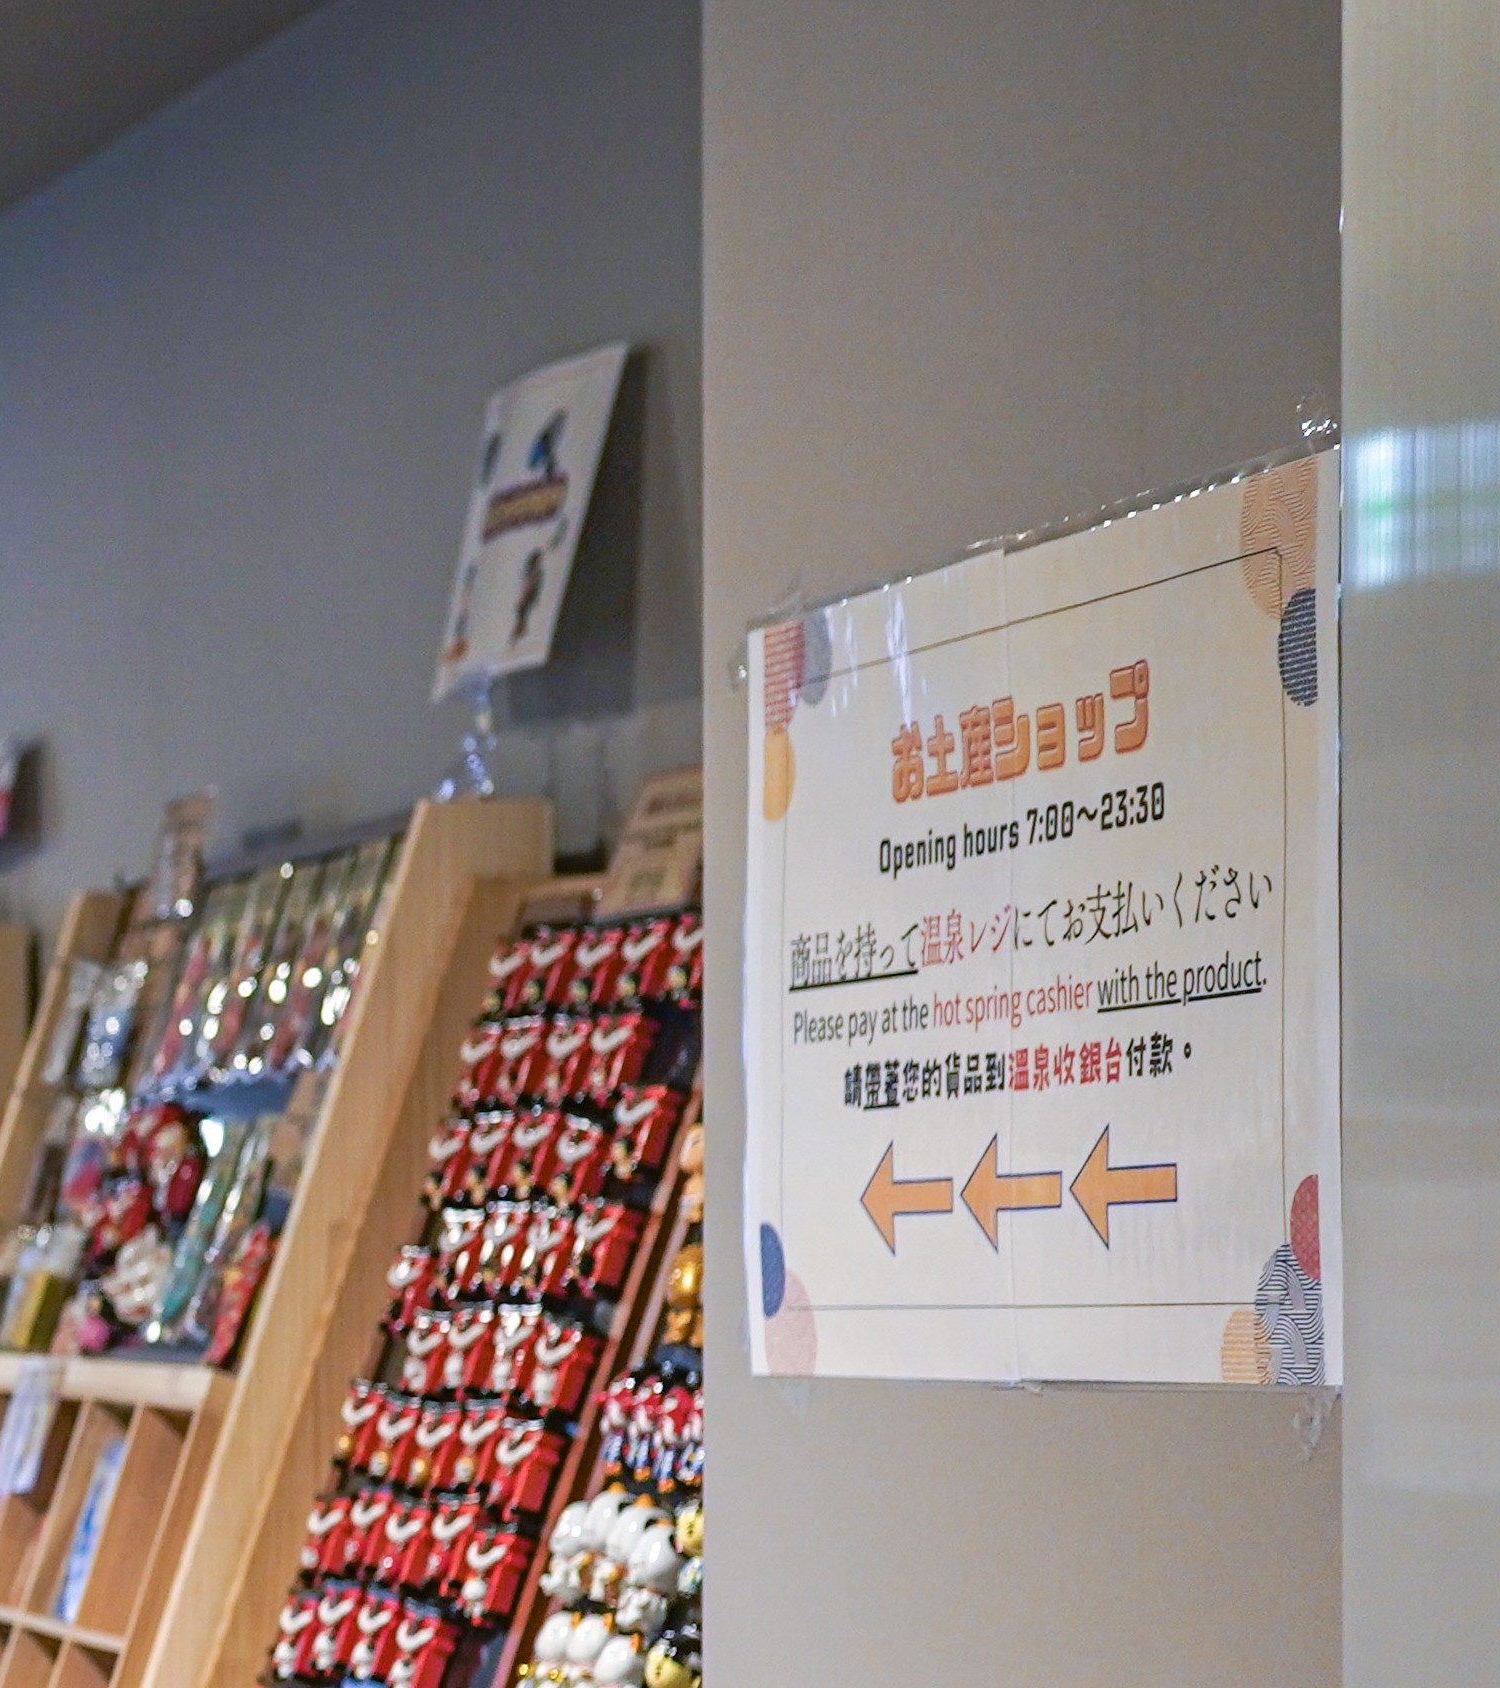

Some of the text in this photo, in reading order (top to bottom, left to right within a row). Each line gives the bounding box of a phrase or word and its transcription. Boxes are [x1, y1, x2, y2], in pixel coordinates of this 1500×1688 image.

[891, 659, 1150, 804] お土産ショップ
[879, 829, 956, 879] Opening
[963, 822, 1019, 858] hours
[790, 865, 1274, 988] 商品を持って温泉レジにてお支払いください
[793, 950, 1268, 1047] Please pay at the hot spring cashier with the product.
